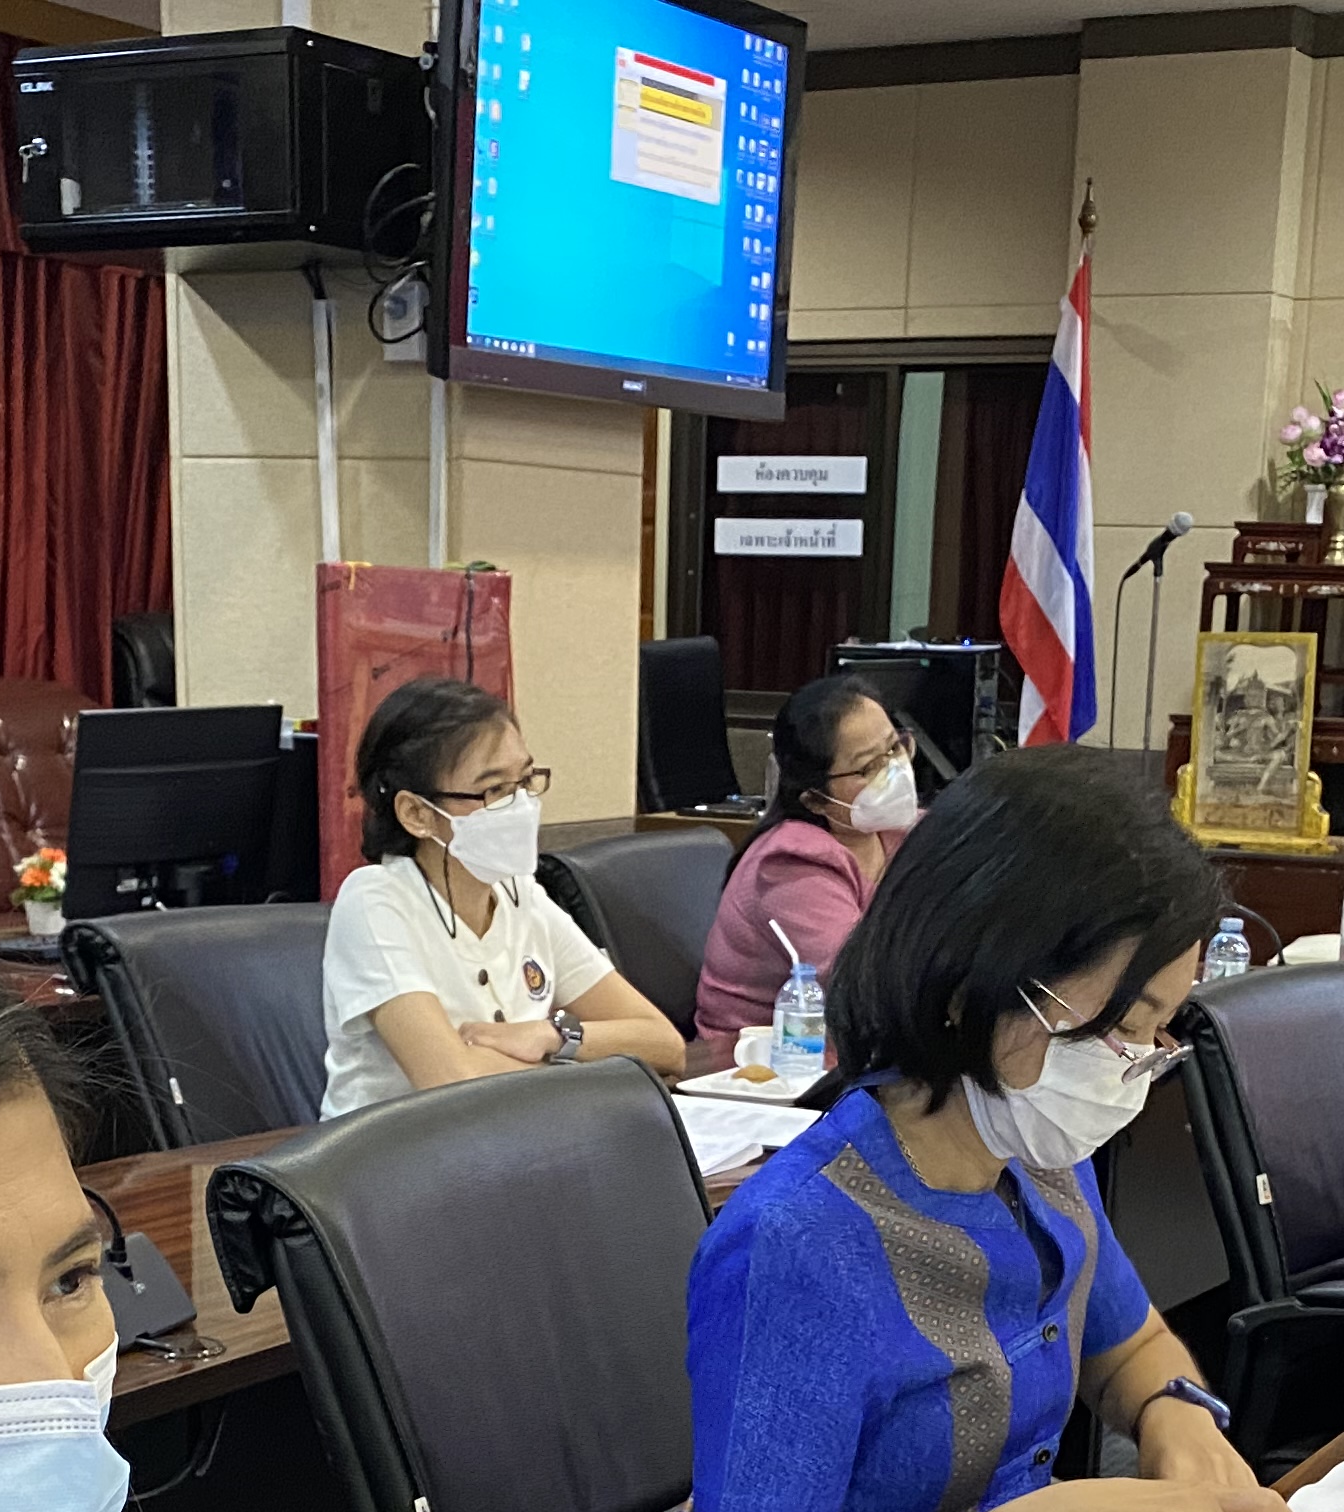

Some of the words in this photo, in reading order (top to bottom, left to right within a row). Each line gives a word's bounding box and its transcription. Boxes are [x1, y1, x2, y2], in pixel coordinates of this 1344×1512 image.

[756, 462, 828, 486] ห้องควบคุม
[740, 523, 836, 548] เฉพาะเจ้าหน้าที่
